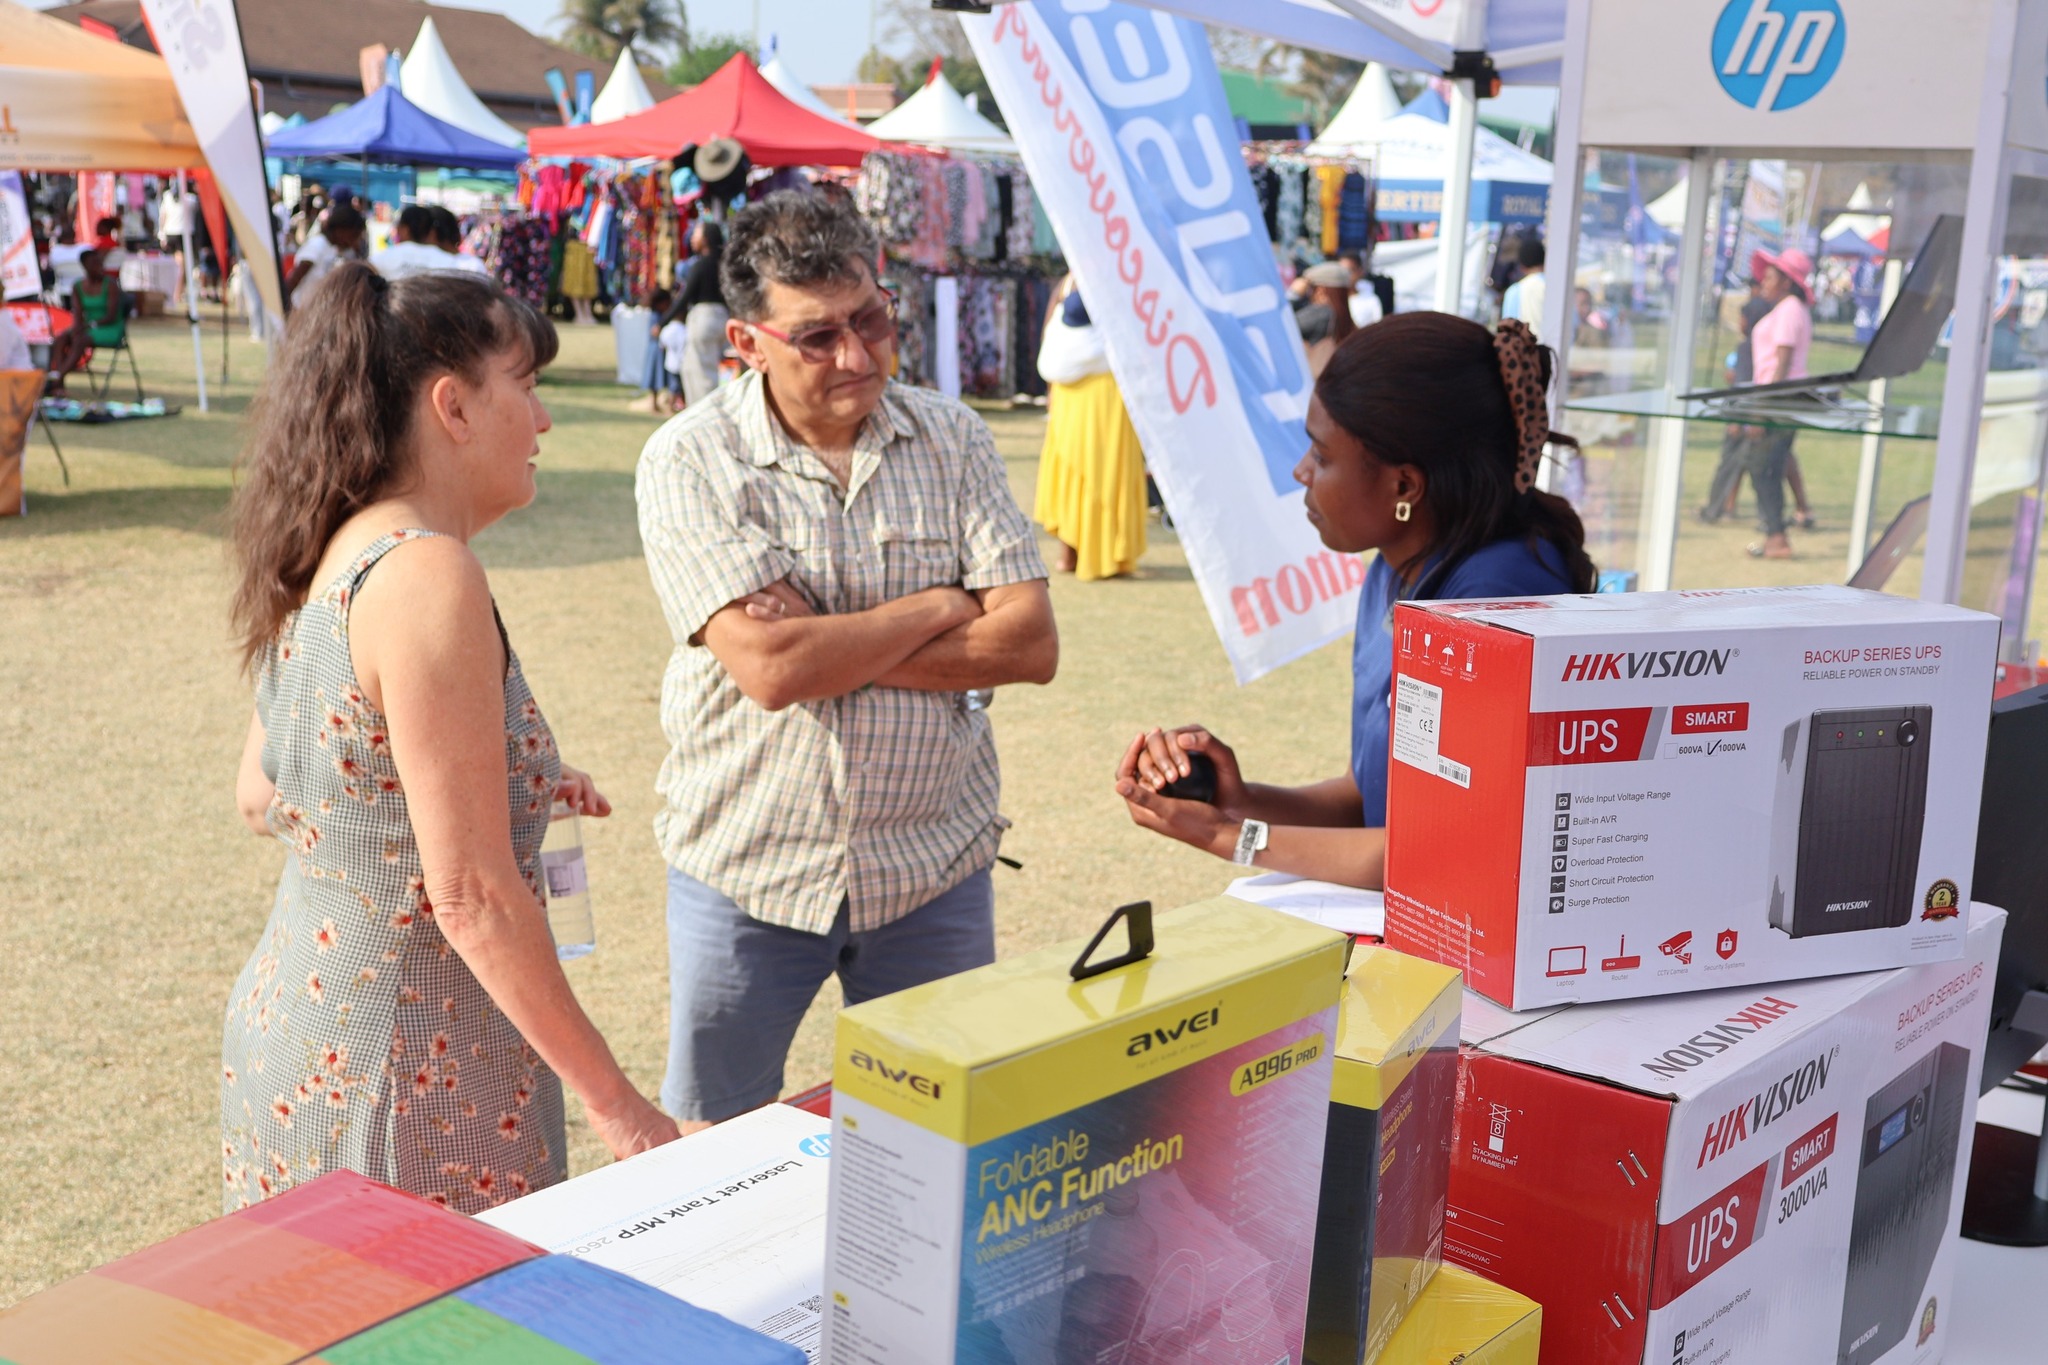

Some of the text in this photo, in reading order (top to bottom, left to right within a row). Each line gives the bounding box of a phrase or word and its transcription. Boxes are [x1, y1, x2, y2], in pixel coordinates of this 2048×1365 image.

[1722, 0, 1836, 110] hp
[1561, 649, 1732, 682] HIKVISION
[1804, 645, 1942, 664] BACKUP SERIES UPS
[1803, 665, 1940, 681] RELIABLE POWER ON STANDBY
[1685, 711, 1736, 726] SMART
[1559, 719, 1619, 755] UPS
[1679, 742, 1746, 755] 600VA 1000VA
[1575, 790, 1671, 805] Wide Input Voltage Range
[1573, 815, 1617, 826] Built-in AVR
[1572, 833, 1649, 847] Super Fast Charging
[1570, 854, 1644, 867] Overload Protection
[1569, 874, 1654, 888] Short Circuit Protection
[1568, 895, 1630, 908] Surge Protection
[1825, 900, 1870, 912] HIKVISION
[1938, 891, 1945, 901] 2
[1669, 967, 1689, 976] Camera
[1703, 962, 1745, 972] Security Systems
[1556, 979, 1575, 987] Laptop
[1898, 961, 1983, 1031] BACKUP SERIES UPS
[1640, 996, 1798, 1079] HIKVISION
[1239, 1049, 1293, 1090] A996
[1296, 1046, 1317, 1065] PRO
[1697, 1047, 1834, 1170] HIKVISION
[1381, 1101, 1413, 1146] Headphone
[1494, 1122, 1501, 1135] 8
[1472, 1147, 1517, 1167] STACKING LIMIT
[1791, 1128, 1831, 1171] SMART
[978, 1128, 1089, 1198] Foldable
[1480, 1156, 1506, 1170] NUMBER
[717, 1160, 803, 1198] LaserJet
[977, 1179, 1053, 1244] ANC
[1060, 1133, 1183, 1209] Function
[1778, 1167, 1828, 1224] 3000VA
[663, 1196, 721, 1219] Tank
[618, 1216, 667, 1240] MFP
[975, 1201, 1105, 1265] Wireless Headphone
[1687, 1195, 1740, 1274] UPS
[1686, 1288, 1752, 1340] Wide Input Voltage Range
[1683, 1338, 1715, 1365] Built-in AVR
